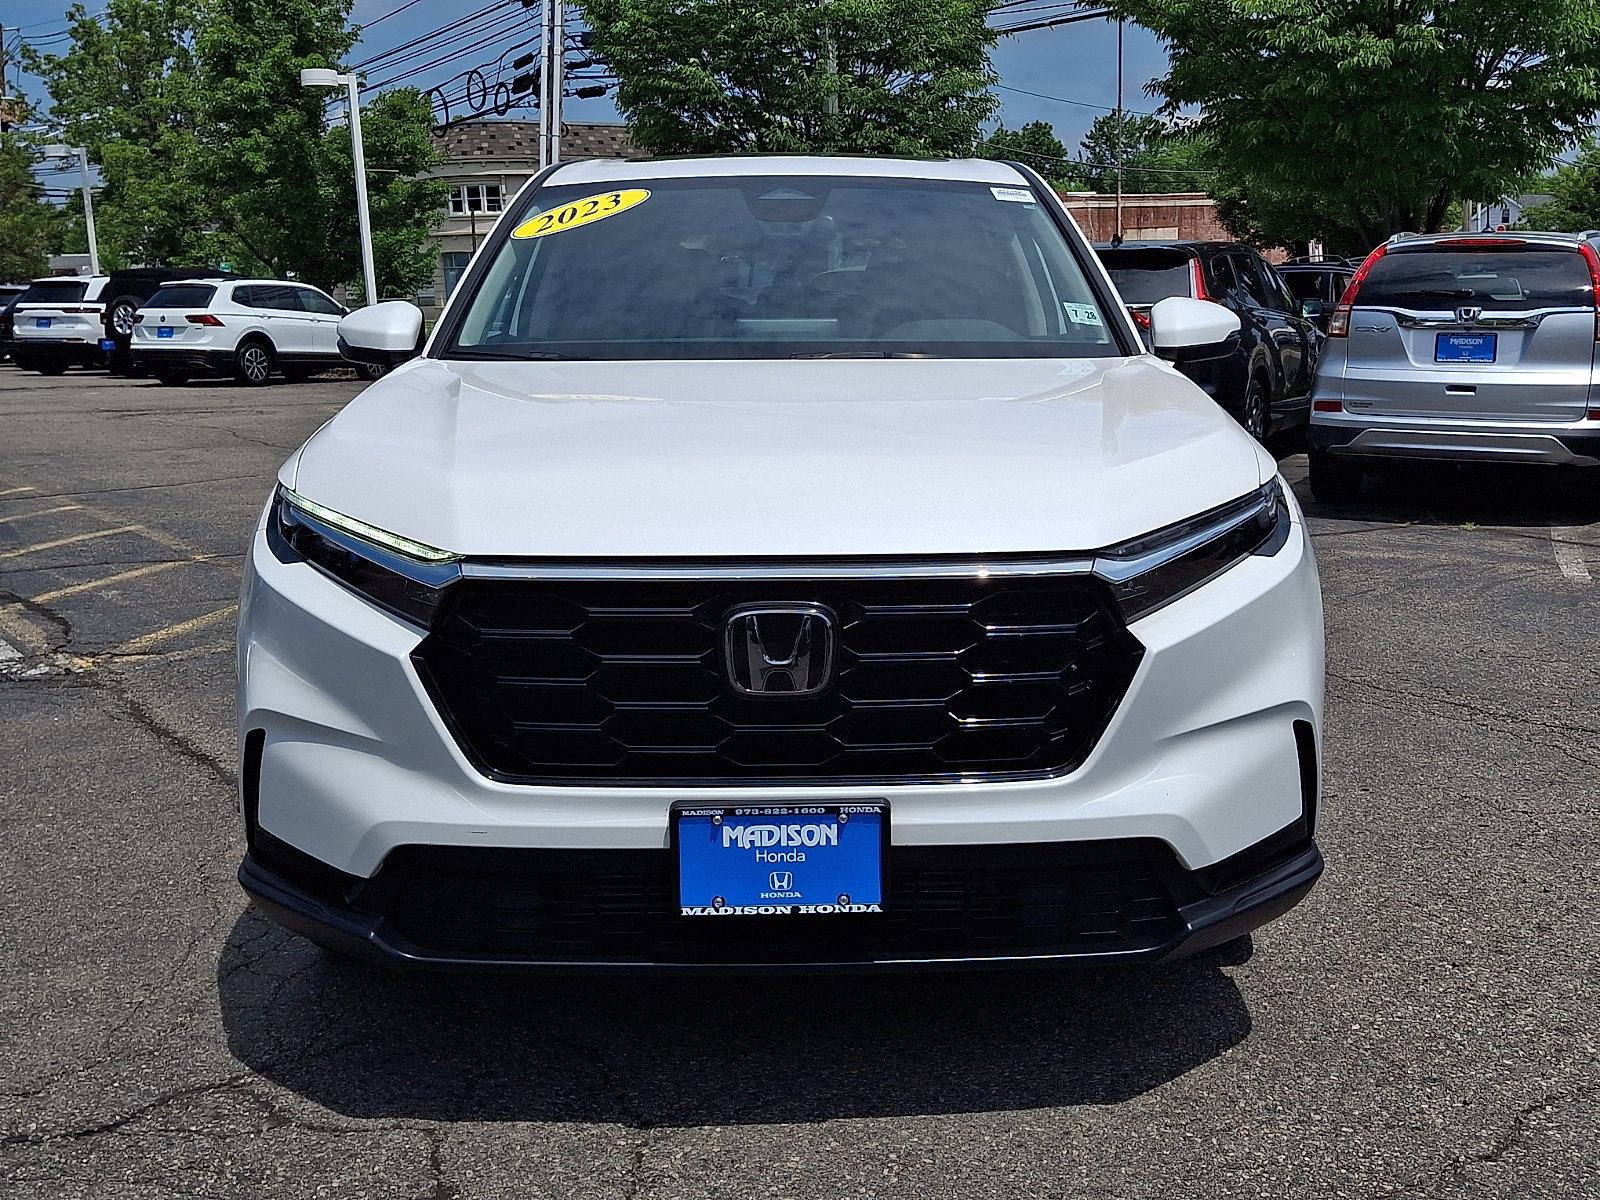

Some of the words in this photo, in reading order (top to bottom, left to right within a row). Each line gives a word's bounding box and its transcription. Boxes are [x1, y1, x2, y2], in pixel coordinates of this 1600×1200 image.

[535, 193, 621, 234] 2023
[1071, 309, 1079, 318] 7
[1084, 310, 1098, 320] 28
[735, 807, 826, 815] 973-822-1600
[722, 824, 838, 849] MADISON
[755, 848, 806, 863] Honda
[760, 891, 802, 899] HONDA
[680, 905, 793, 916] MADISON
[798, 903, 884, 914] HONDA
